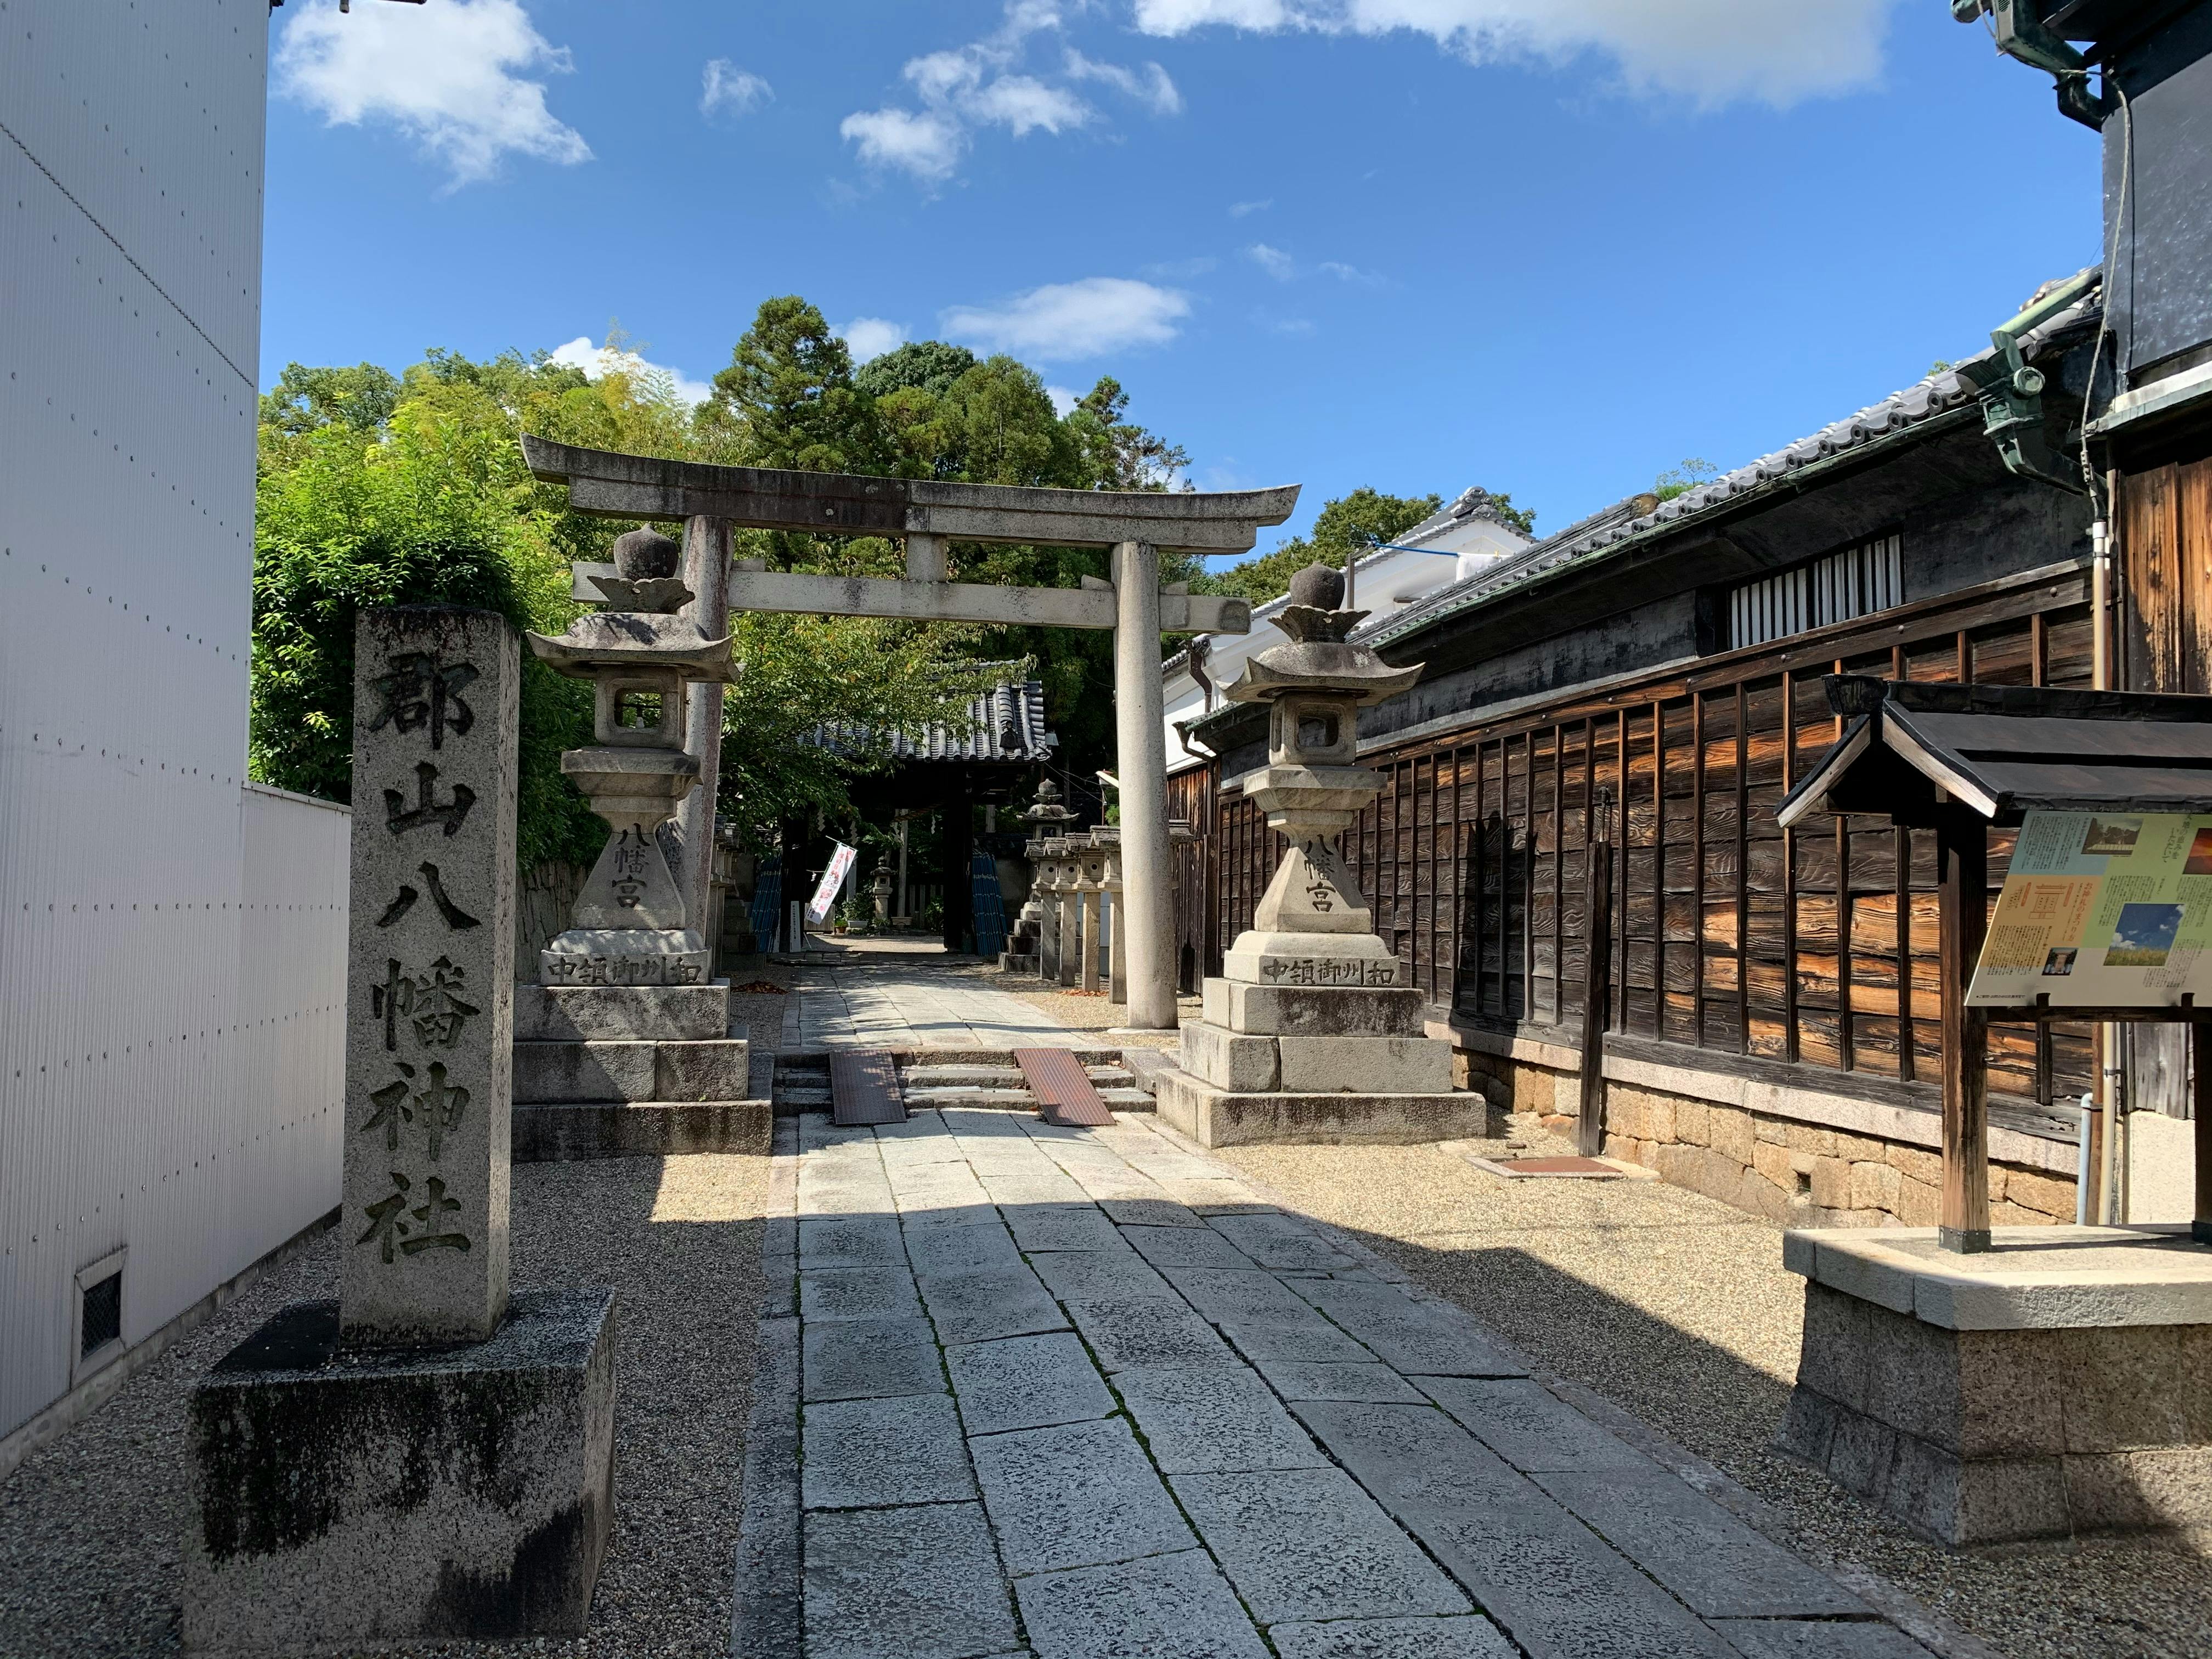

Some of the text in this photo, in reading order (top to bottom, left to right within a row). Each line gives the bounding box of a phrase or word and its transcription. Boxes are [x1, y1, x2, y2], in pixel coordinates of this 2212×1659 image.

[612, 823, 651, 909] 八幡宮
[1304, 834, 1336, 912] 八幡宮
[356, 653, 482, 1265] 郡山八幡神社
